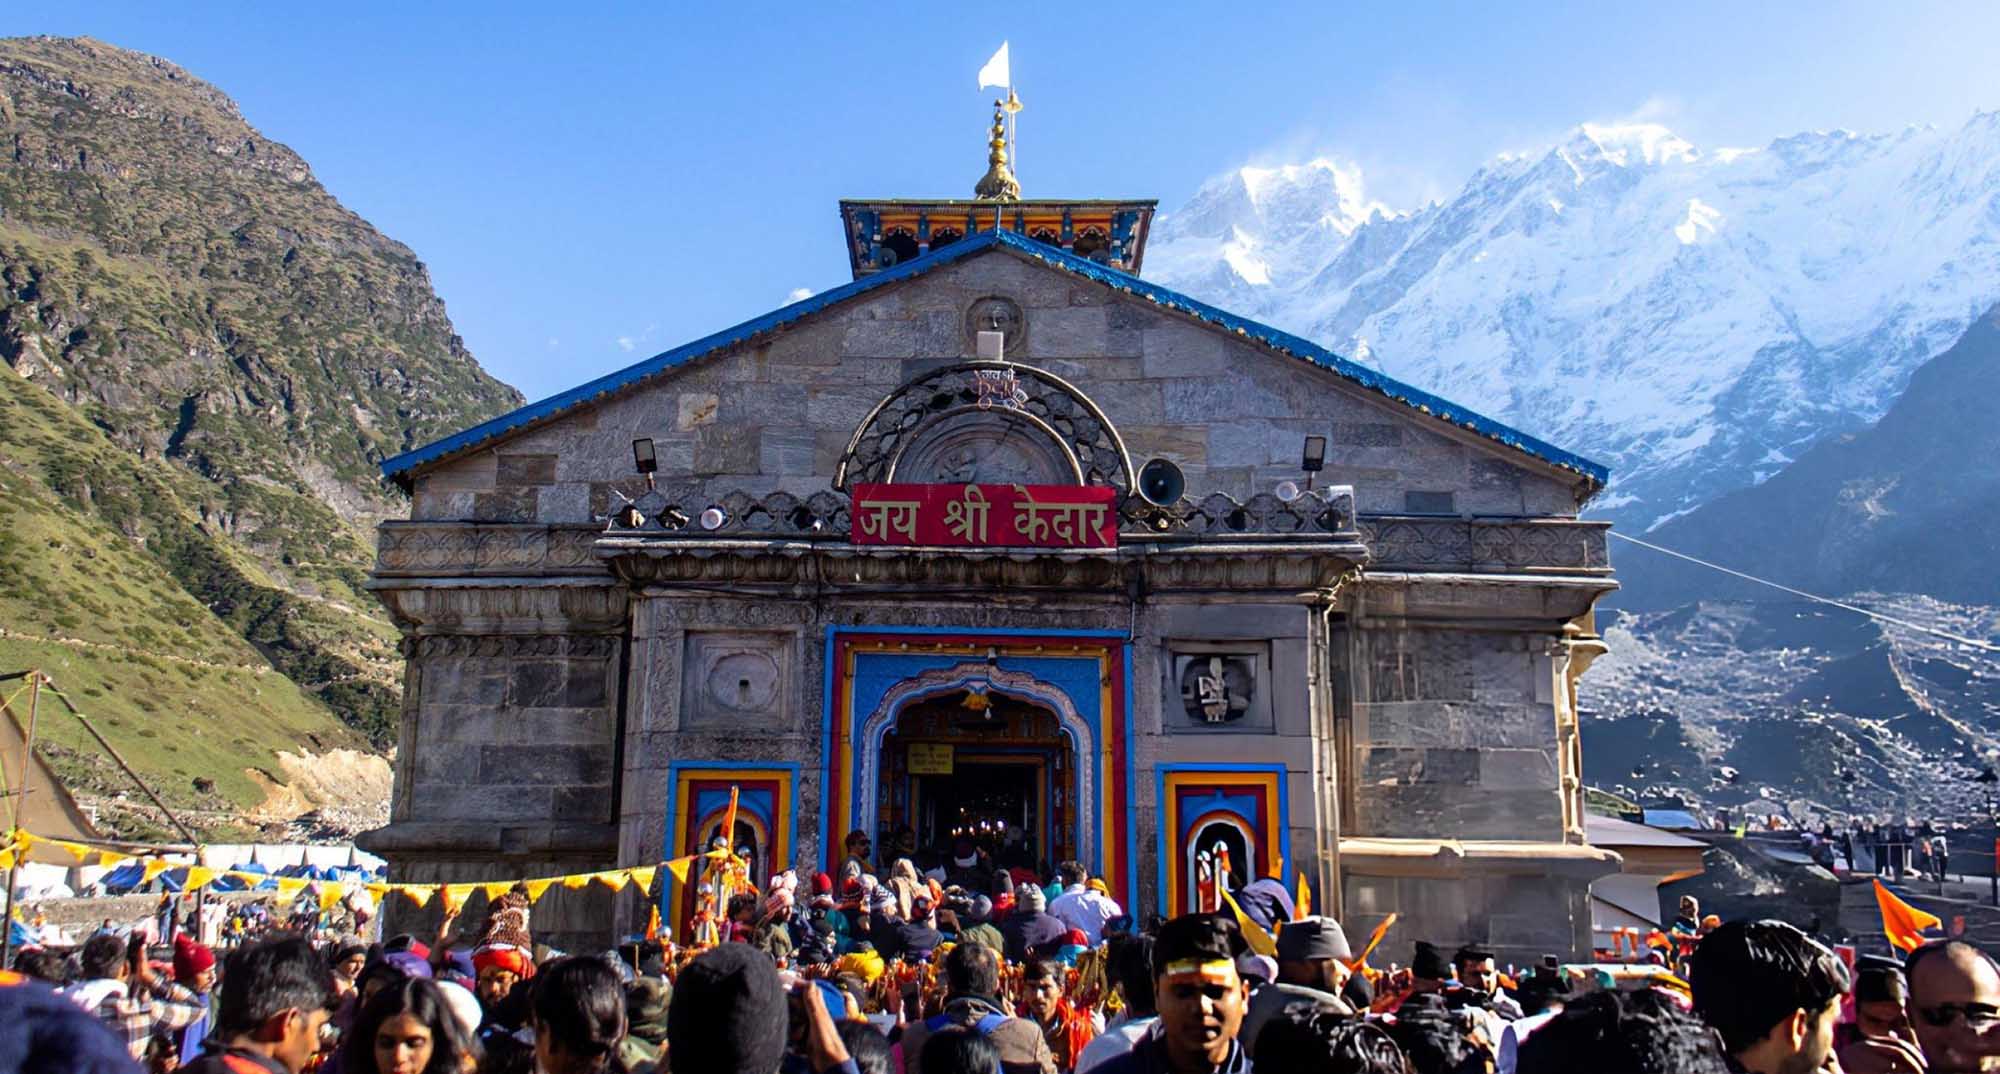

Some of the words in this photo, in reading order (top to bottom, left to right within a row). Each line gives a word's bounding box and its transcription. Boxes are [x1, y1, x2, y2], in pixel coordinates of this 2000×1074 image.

[860, 501, 920, 542] जय
[943, 484, 991, 543] श्री
[1013, 483, 1108, 545] केदार
